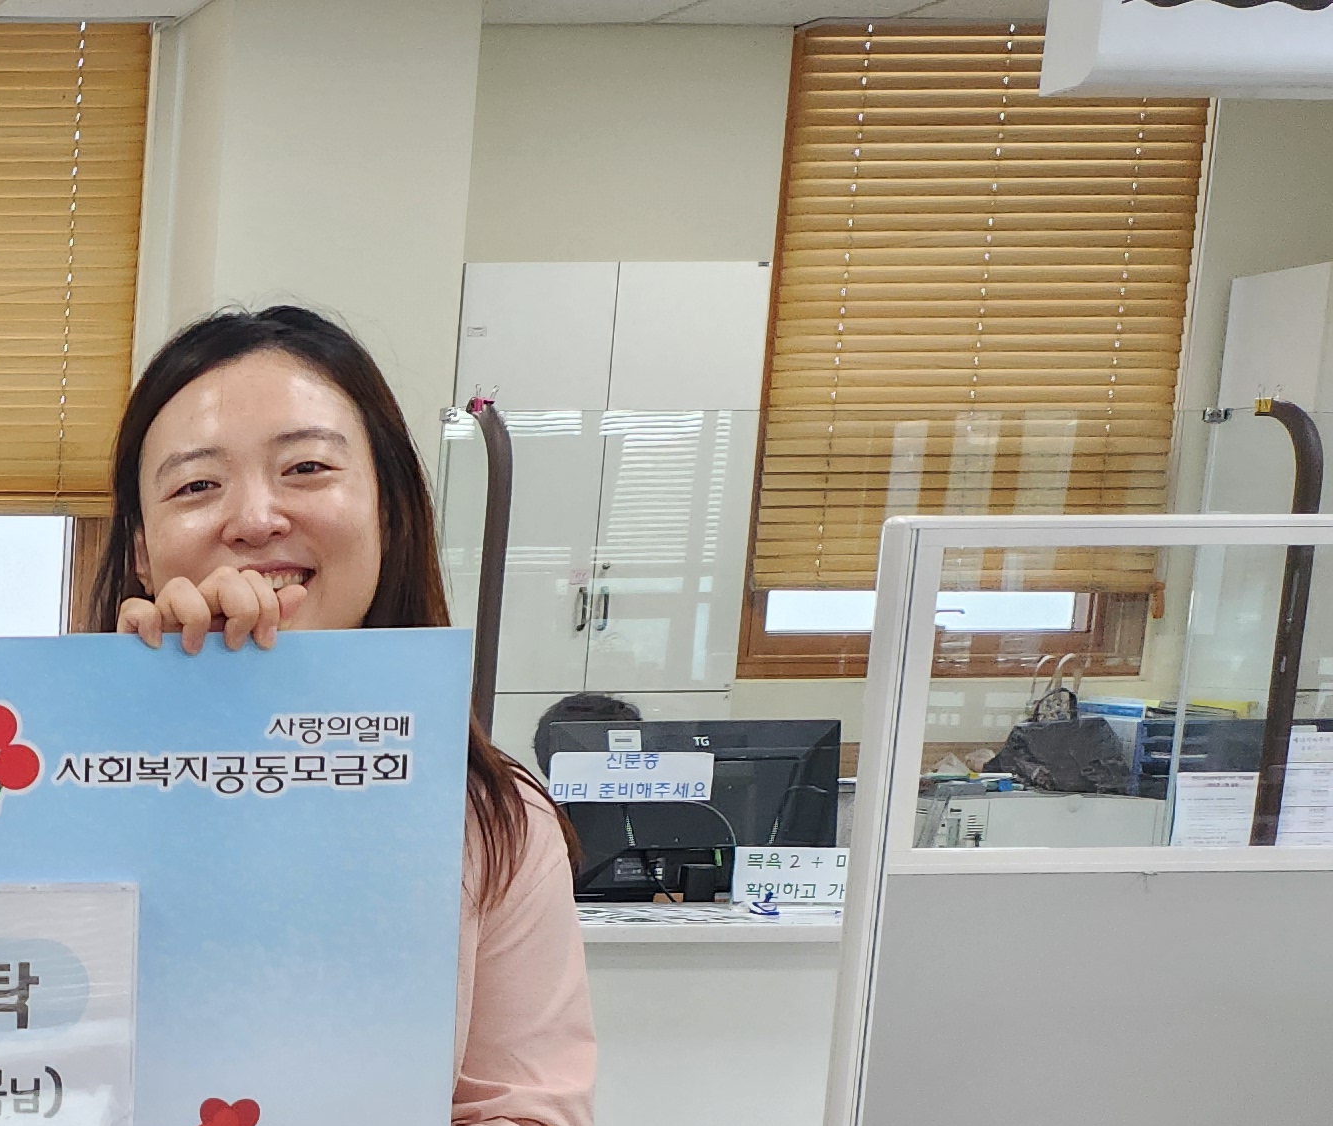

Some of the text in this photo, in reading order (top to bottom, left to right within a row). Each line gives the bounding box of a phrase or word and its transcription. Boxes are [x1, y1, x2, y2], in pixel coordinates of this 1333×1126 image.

[268, 713, 412, 743] 사랑의열매
[693, 736, 710, 748] TG
[606, 752, 660, 770] 신분증
[55, 752, 411, 796] 사회복지공동모금회
[553, 781, 707, 799] 미리 준비해주세요
[747, 853, 782, 870] 목욕
[789, 854, 801, 869] 2
[745, 882, 817, 900] 확인하고
